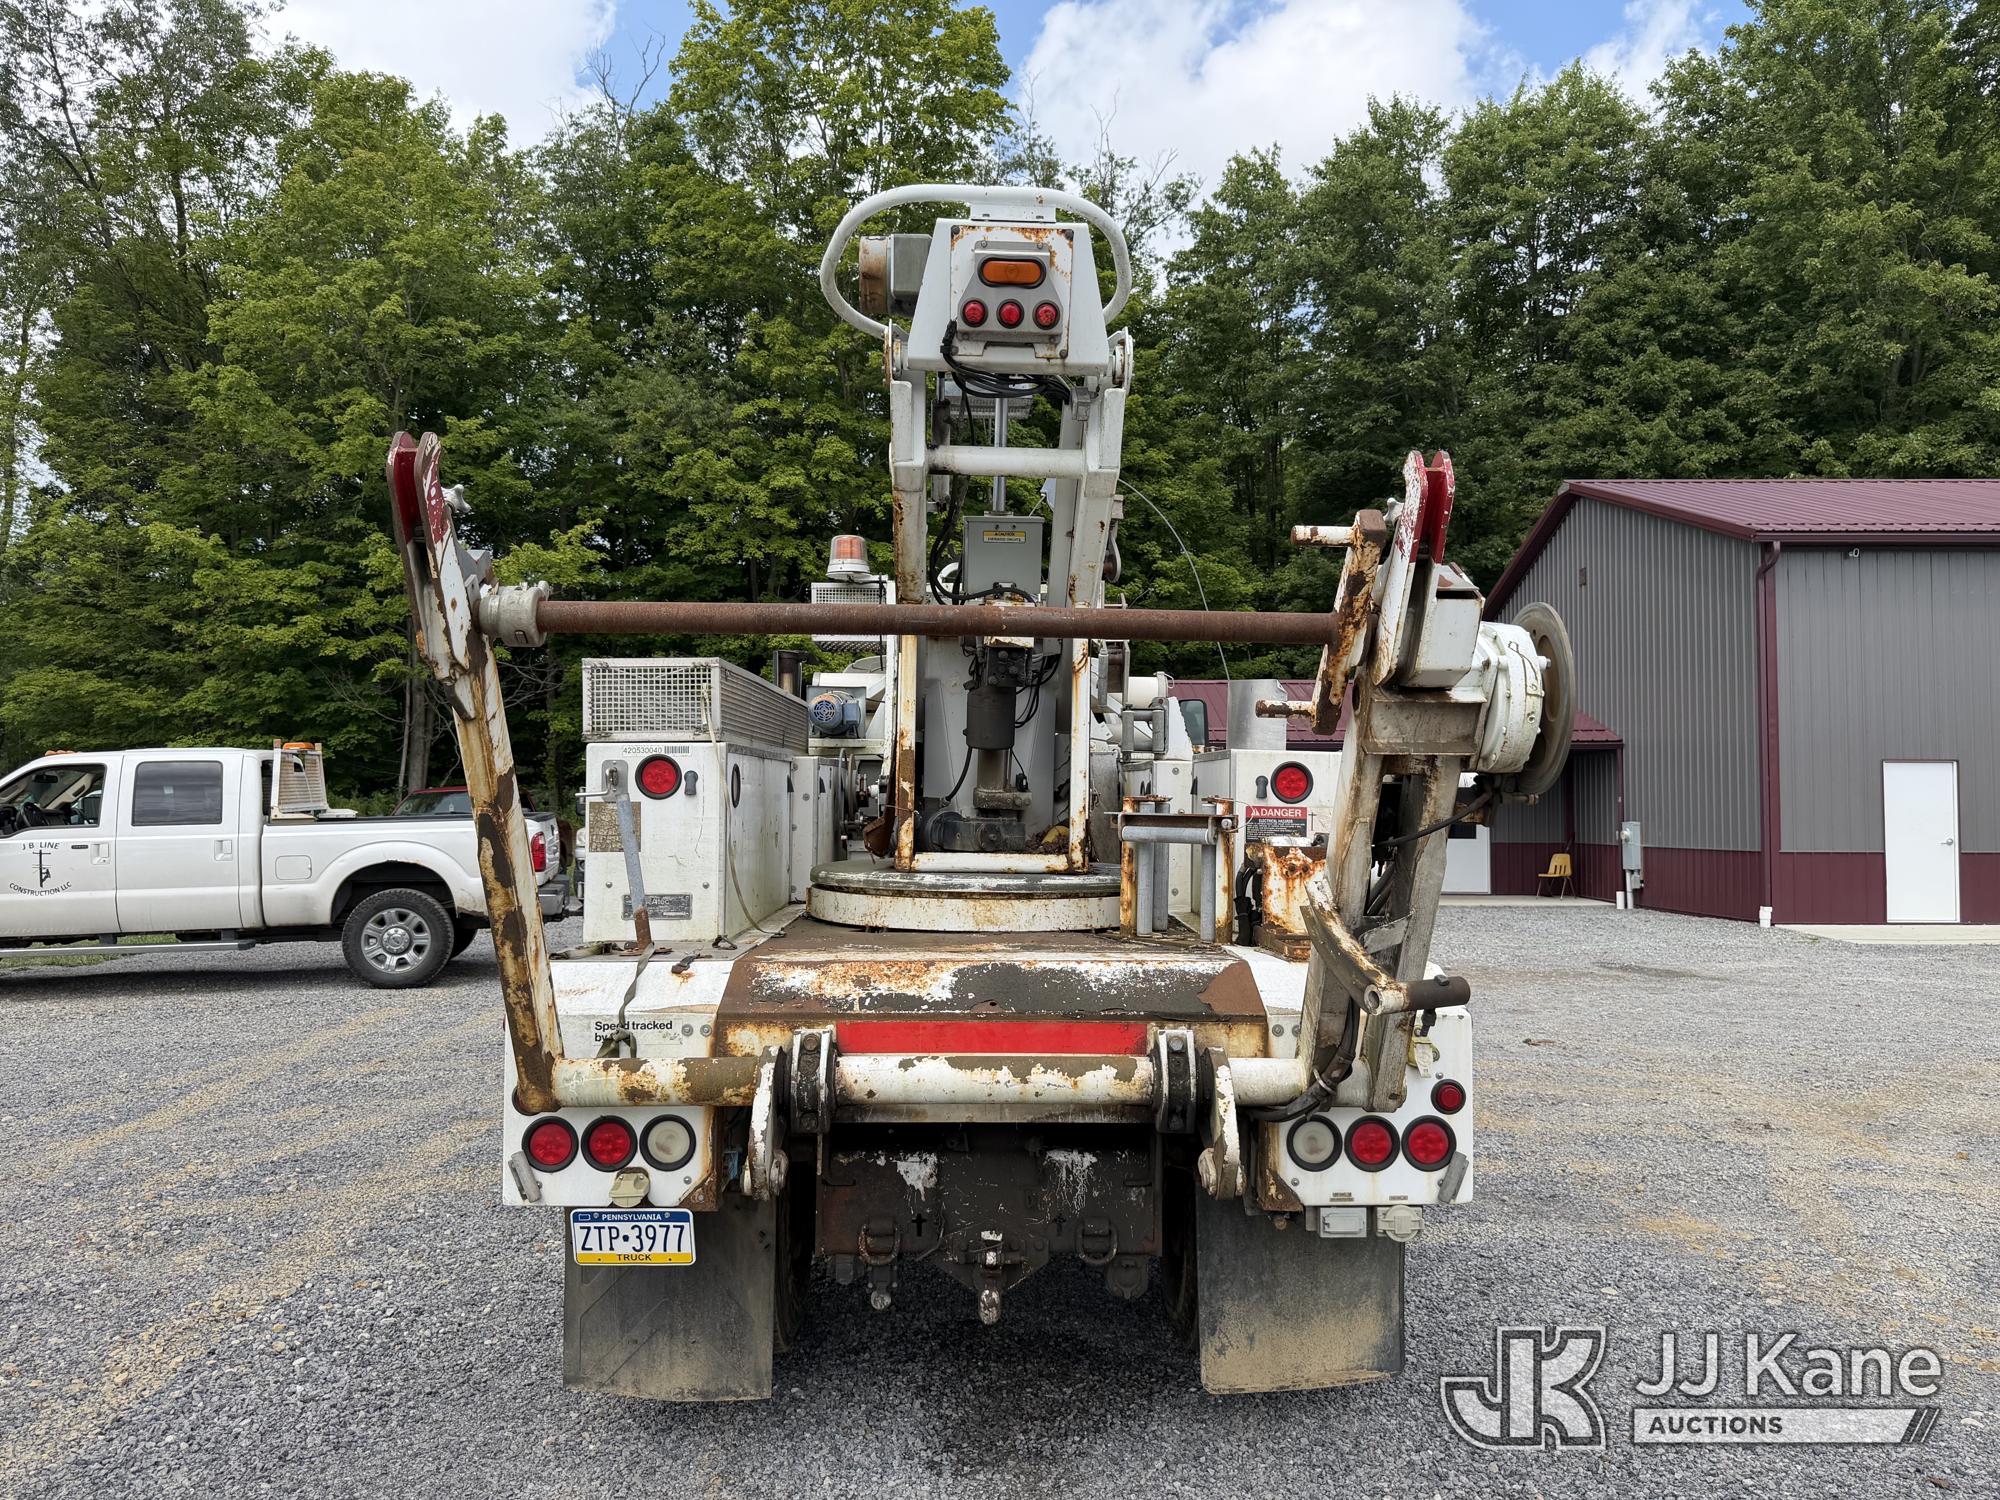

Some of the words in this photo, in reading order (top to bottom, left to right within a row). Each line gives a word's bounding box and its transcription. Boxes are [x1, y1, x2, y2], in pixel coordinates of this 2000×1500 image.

[623, 746, 663, 754] 420530040
[1260, 808, 1302, 817] DANGER
[22, 843, 26, 851] J
[40, 841, 60, 850] LINE
[9, 882, 60, 896] CONSTRUCTION
[60, 881, 72, 891] LLC
[631, 1020, 673, 1030] tracked
[602, 1213, 662, 1221] PENNSYLVANIA
[617, 1253, 652, 1261] TRUCK
